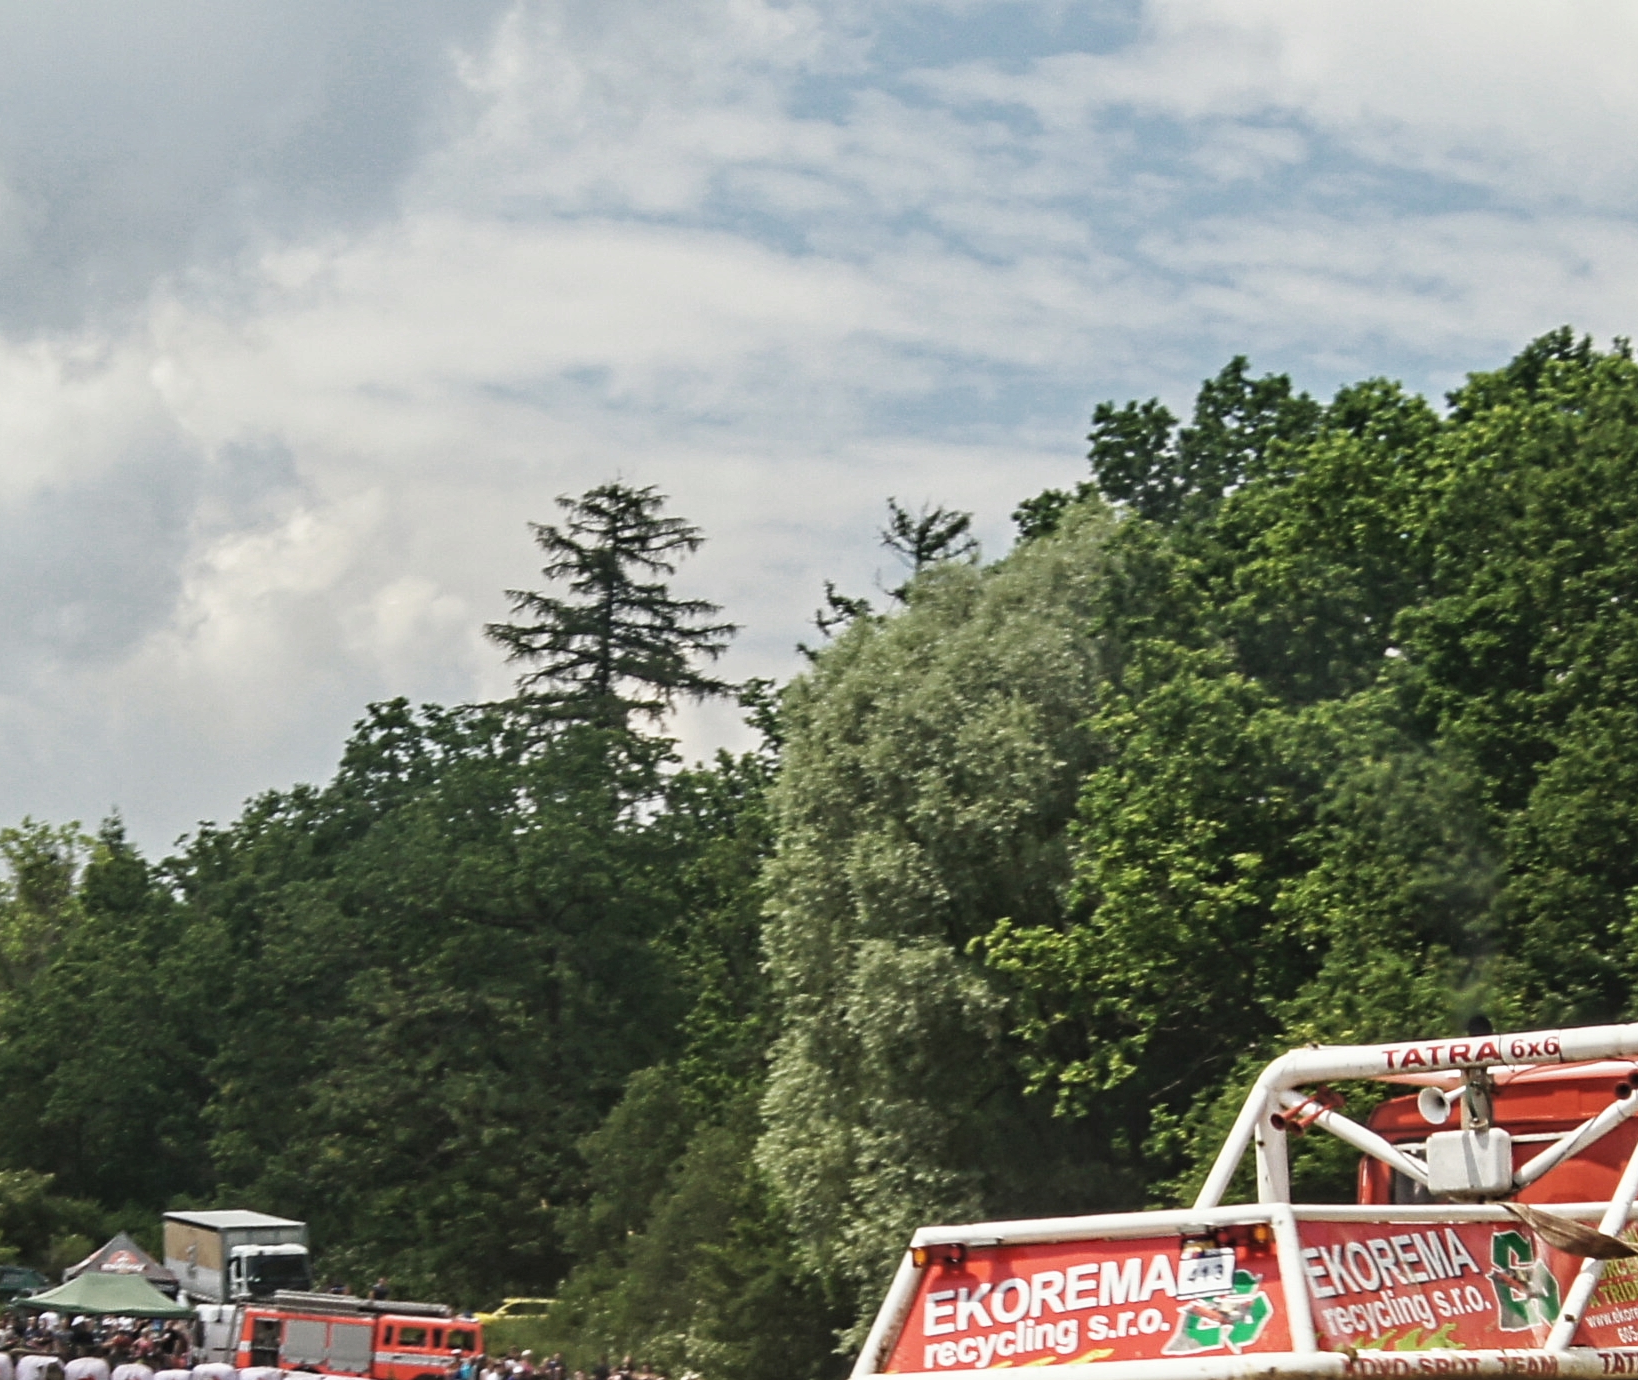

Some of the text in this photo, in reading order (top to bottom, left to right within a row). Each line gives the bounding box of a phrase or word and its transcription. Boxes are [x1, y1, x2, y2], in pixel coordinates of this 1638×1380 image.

[1381, 1036, 1560, 1068] TATRA 6x6
[1303, 1228, 1482, 1300] EKOREMA
[922, 1253, 1179, 1338] EKOREMA
[1322, 1281, 1492, 1340] recycling s.r.o.
[923, 1308, 1171, 1370] recycling s.r.o.
